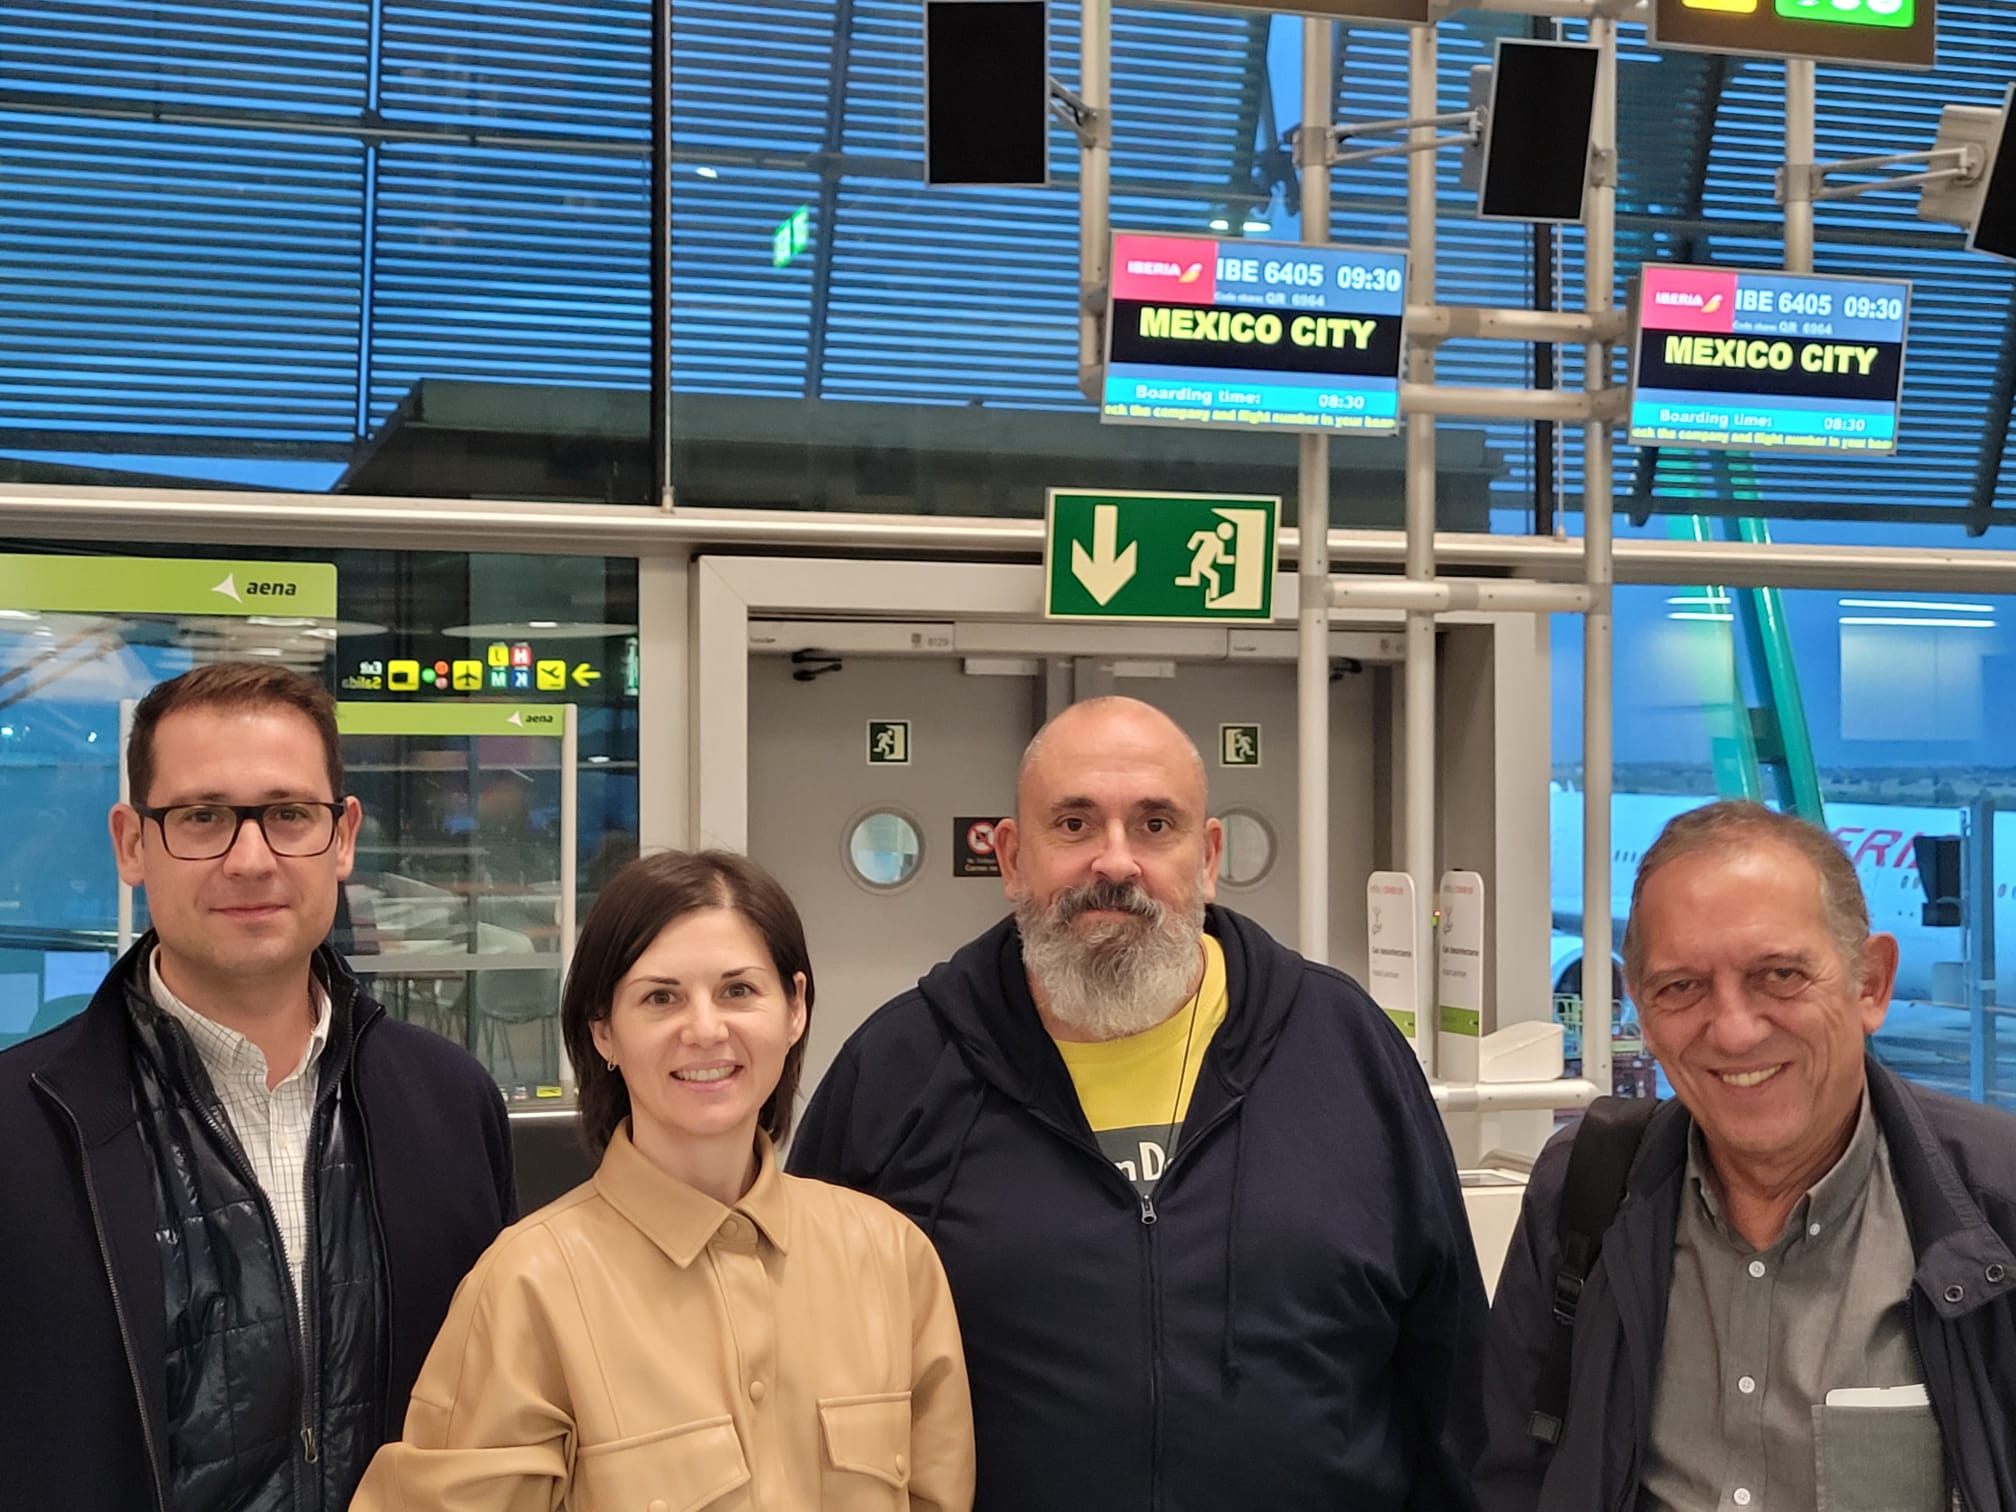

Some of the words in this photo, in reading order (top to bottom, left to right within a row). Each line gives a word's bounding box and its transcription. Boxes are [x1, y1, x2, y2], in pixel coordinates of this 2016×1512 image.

[1128, 261, 1181, 277] IBERIA
[1216, 258, 1259, 282] IBE
[1264, 261, 1323, 287] 6405
[1337, 266, 1401, 292] 09:30
[1655, 292, 1703, 307] IBERIA
[1735, 289, 1773, 313] IBE
[1778, 291, 1832, 316] 6405
[1844, 296, 1902, 320] 09:30
[1139, 306, 1283, 345] MEXICO
[1290, 316, 1376, 350] CITY
[1664, 335, 1793, 371] MEXICO
[1800, 344, 1879, 375] CITY
[1136, 384, 1212, 405] Boarding
[1218, 388, 1261, 405] time:
[1318, 393, 1365, 409] 08:30
[1130, 404, 1151, 417] the
[1153, 406, 1210, 422] company
[1212, 408, 1237, 421] and
[1238, 409, 1271, 424] flight
[1272, 412, 1319, 425] number
[1660, 409, 1728, 427] Boarding
[1734, 412, 1772, 427] time:
[1824, 417, 1865, 432] 08:30
[1678, 429, 1729, 443] company
[1731, 432, 1753, 443] and
[1754, 432, 1783, 446] flight
[1785, 434, 1827, 447] number
[246, 579, 296, 597] aena
[526, 714, 553, 724] aena
